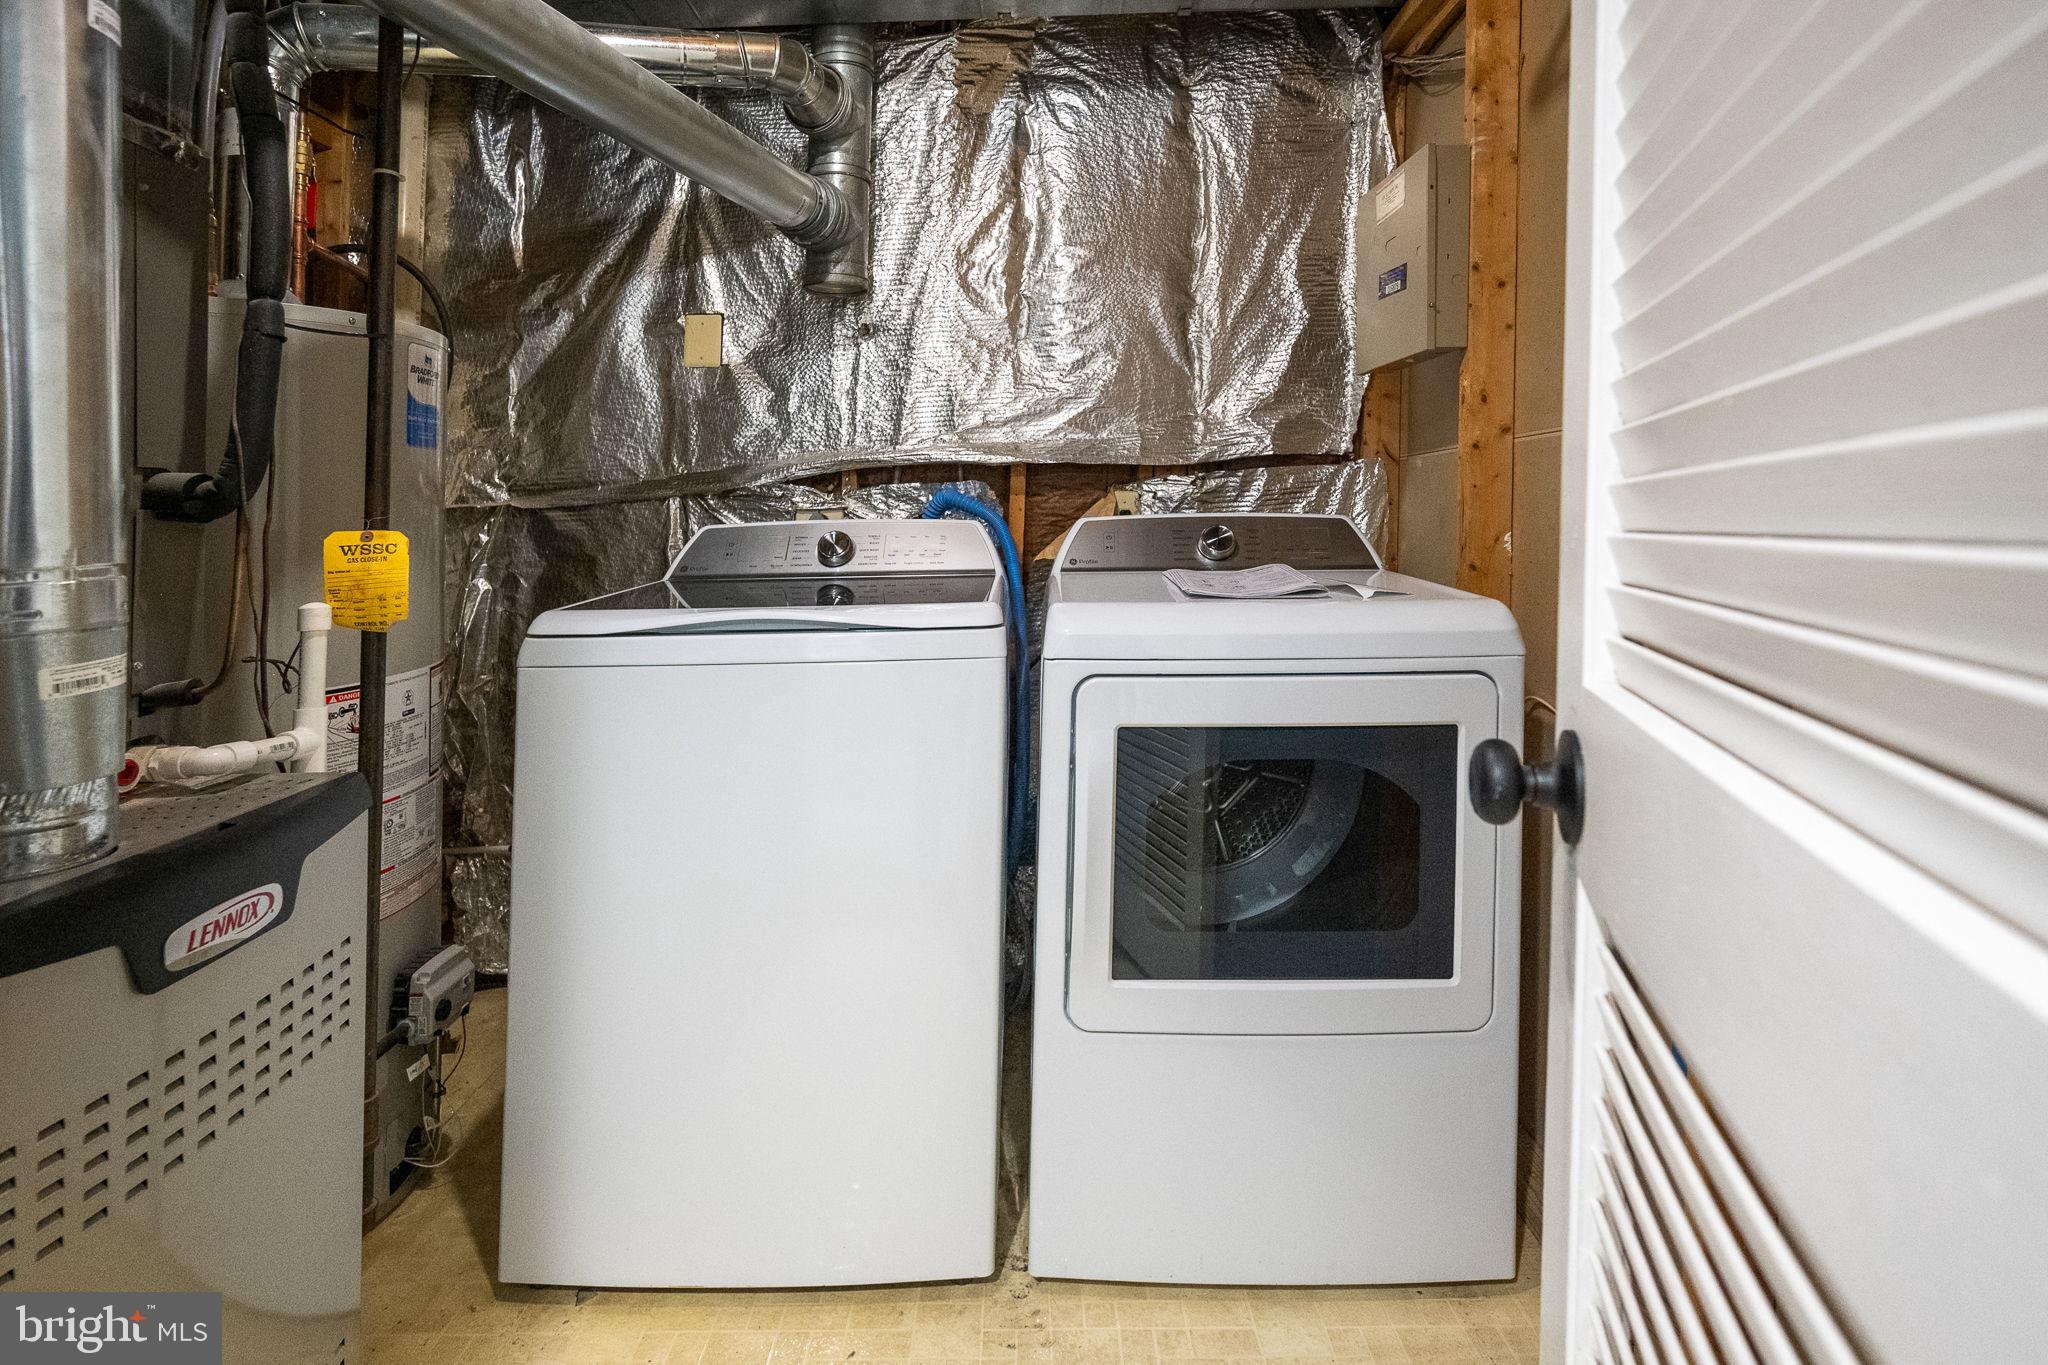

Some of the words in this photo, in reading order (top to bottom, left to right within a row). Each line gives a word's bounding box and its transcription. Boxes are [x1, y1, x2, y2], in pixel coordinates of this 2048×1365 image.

[339, 543, 397, 556] WSSC
[338, 691, 360, 701] DANGE
[187, 898, 260, 954] LENNOX
